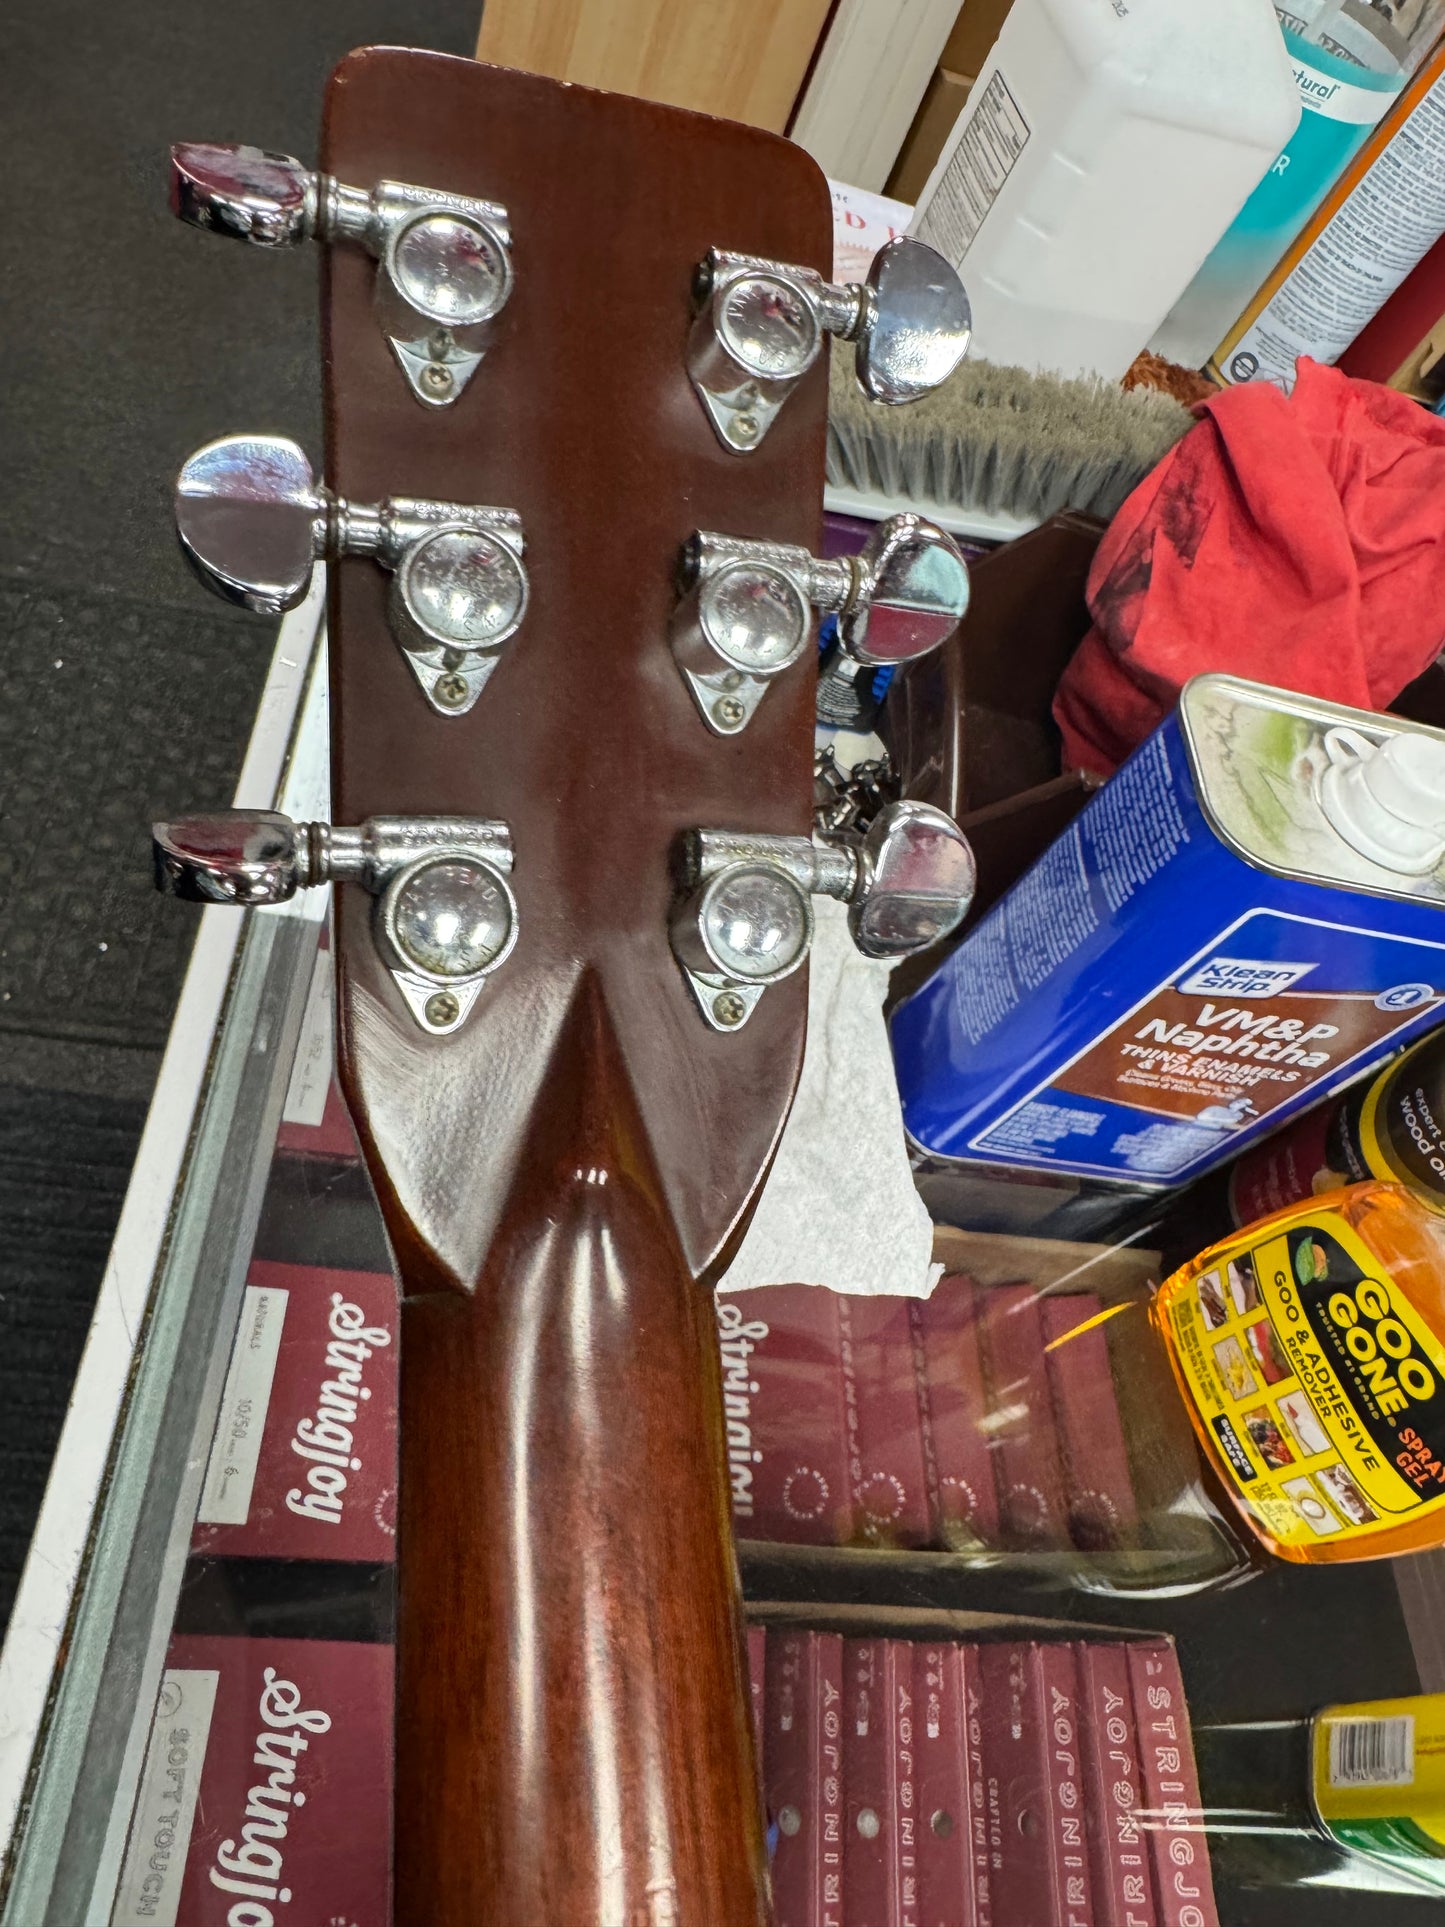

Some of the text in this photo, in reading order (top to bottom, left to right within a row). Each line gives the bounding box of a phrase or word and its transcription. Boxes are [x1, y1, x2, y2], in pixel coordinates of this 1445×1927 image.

[1292, 68, 1336, 99] tural
[1197, 976, 1269, 993] Strip
[1201, 963, 1297, 982] Klean
[1120, 1043, 1302, 1082] THINS ENAMELS
[1134, 1018, 1331, 1068] Naphtha
[1195, 1003, 1340, 1043] VM&P
[1136, 1059, 1156, 1071] &
[1160, 1062, 1261, 1087] VARNISH
[1273, 1270, 1381, 1473] GOO & ADHESIVE
[1286, 1337, 1332, 1419] REMOVER
[1328, 1292, 1410, 1417] GONE
[1355, 1278, 1436, 1401] GOO
[286, 1292, 391, 1524] Stringjoy
[1396, 1451, 1430, 1489] GEL
[209, 1667, 332, 1927] Stringjo
[1051, 1686, 1086, 1927] TRINGJOY
[1102, 1686, 1147, 1927] TRINGJOY
[1147, 1685, 1204, 1927] STRINGJO
